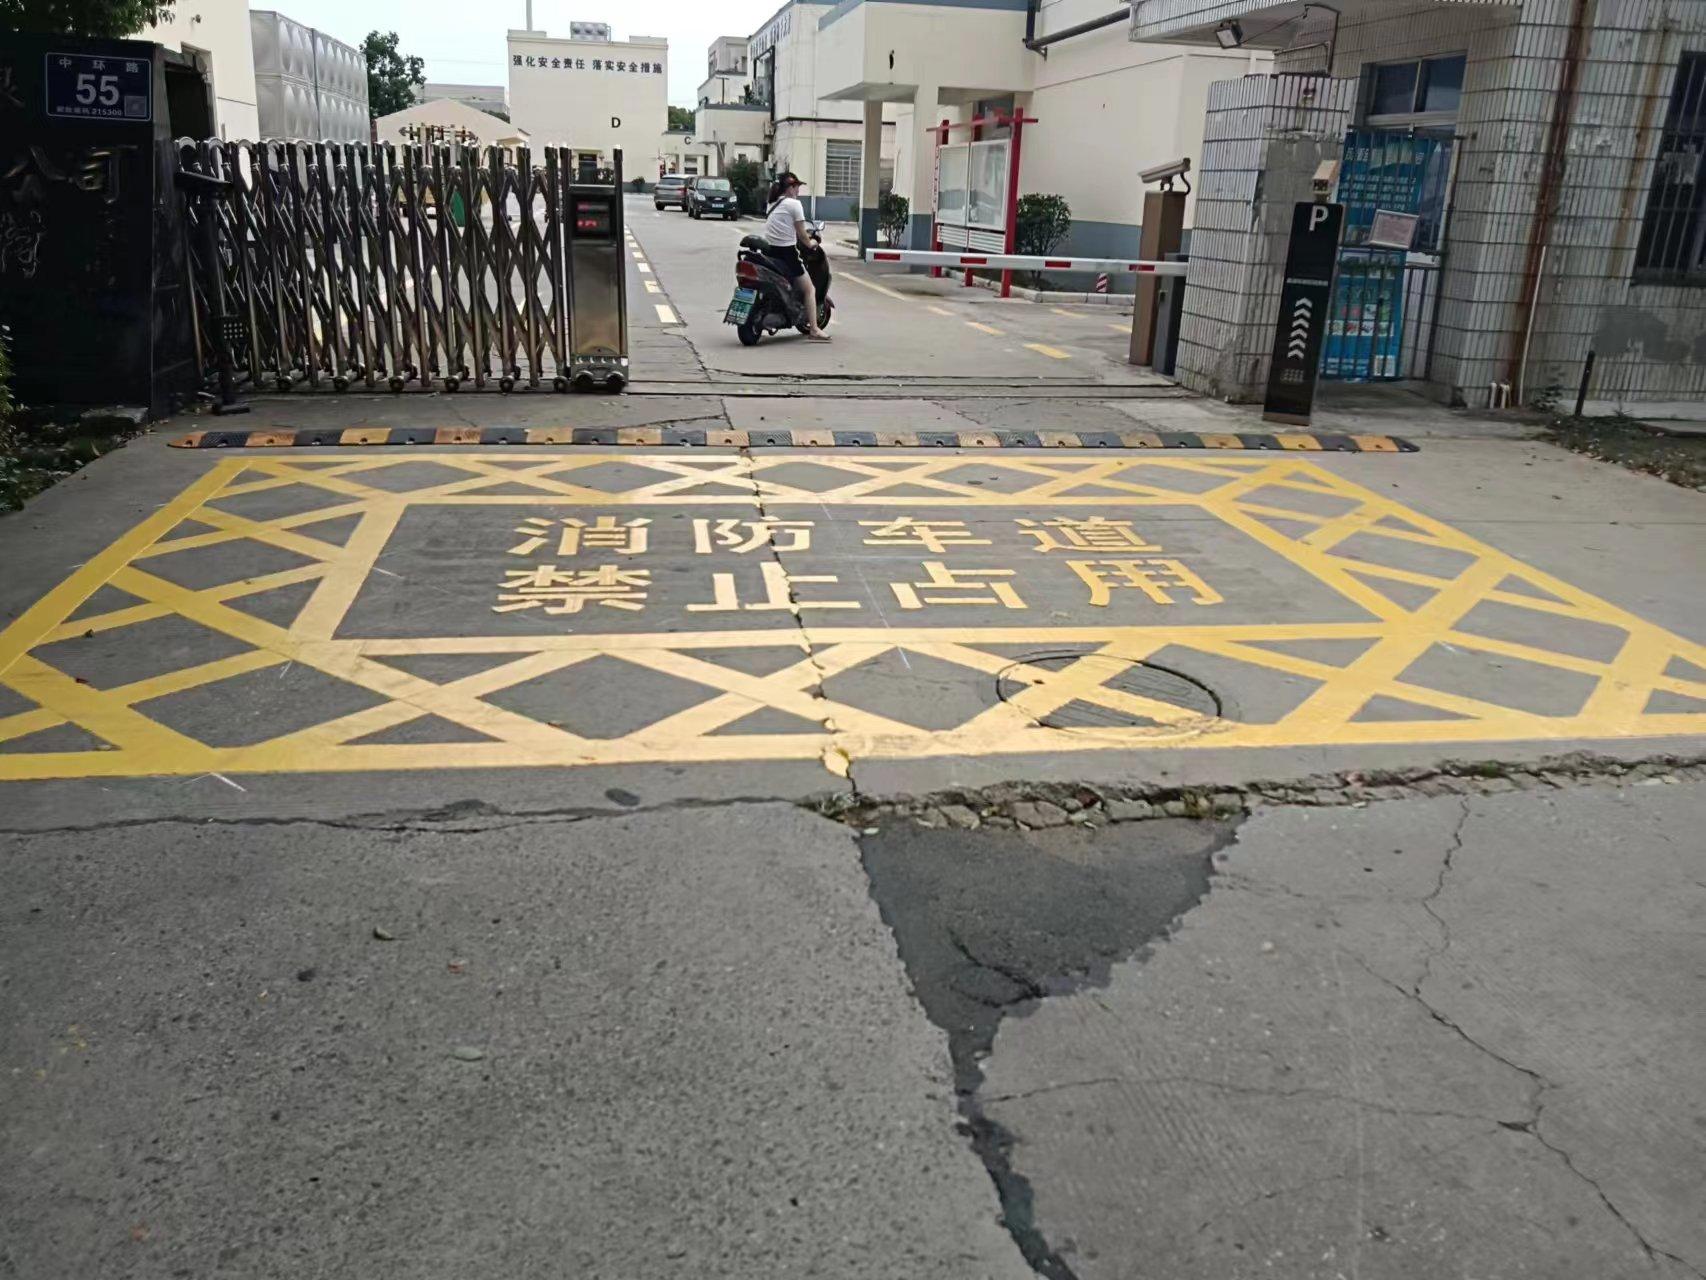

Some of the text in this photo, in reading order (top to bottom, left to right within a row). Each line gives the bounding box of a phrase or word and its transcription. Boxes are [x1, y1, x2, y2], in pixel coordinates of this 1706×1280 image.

[59, 57, 139, 73] 中环路
[513, 55, 663, 74] 强化安全责任 落实安全措施
[76, 73, 119, 106] 55
[611, 117, 621, 128] D
[684, 136, 692, 145] C
[1308, 205, 1329, 231] P
[507, 516, 1163, 555] 消防车道
[491, 559, 1225, 615] 禁止占用
